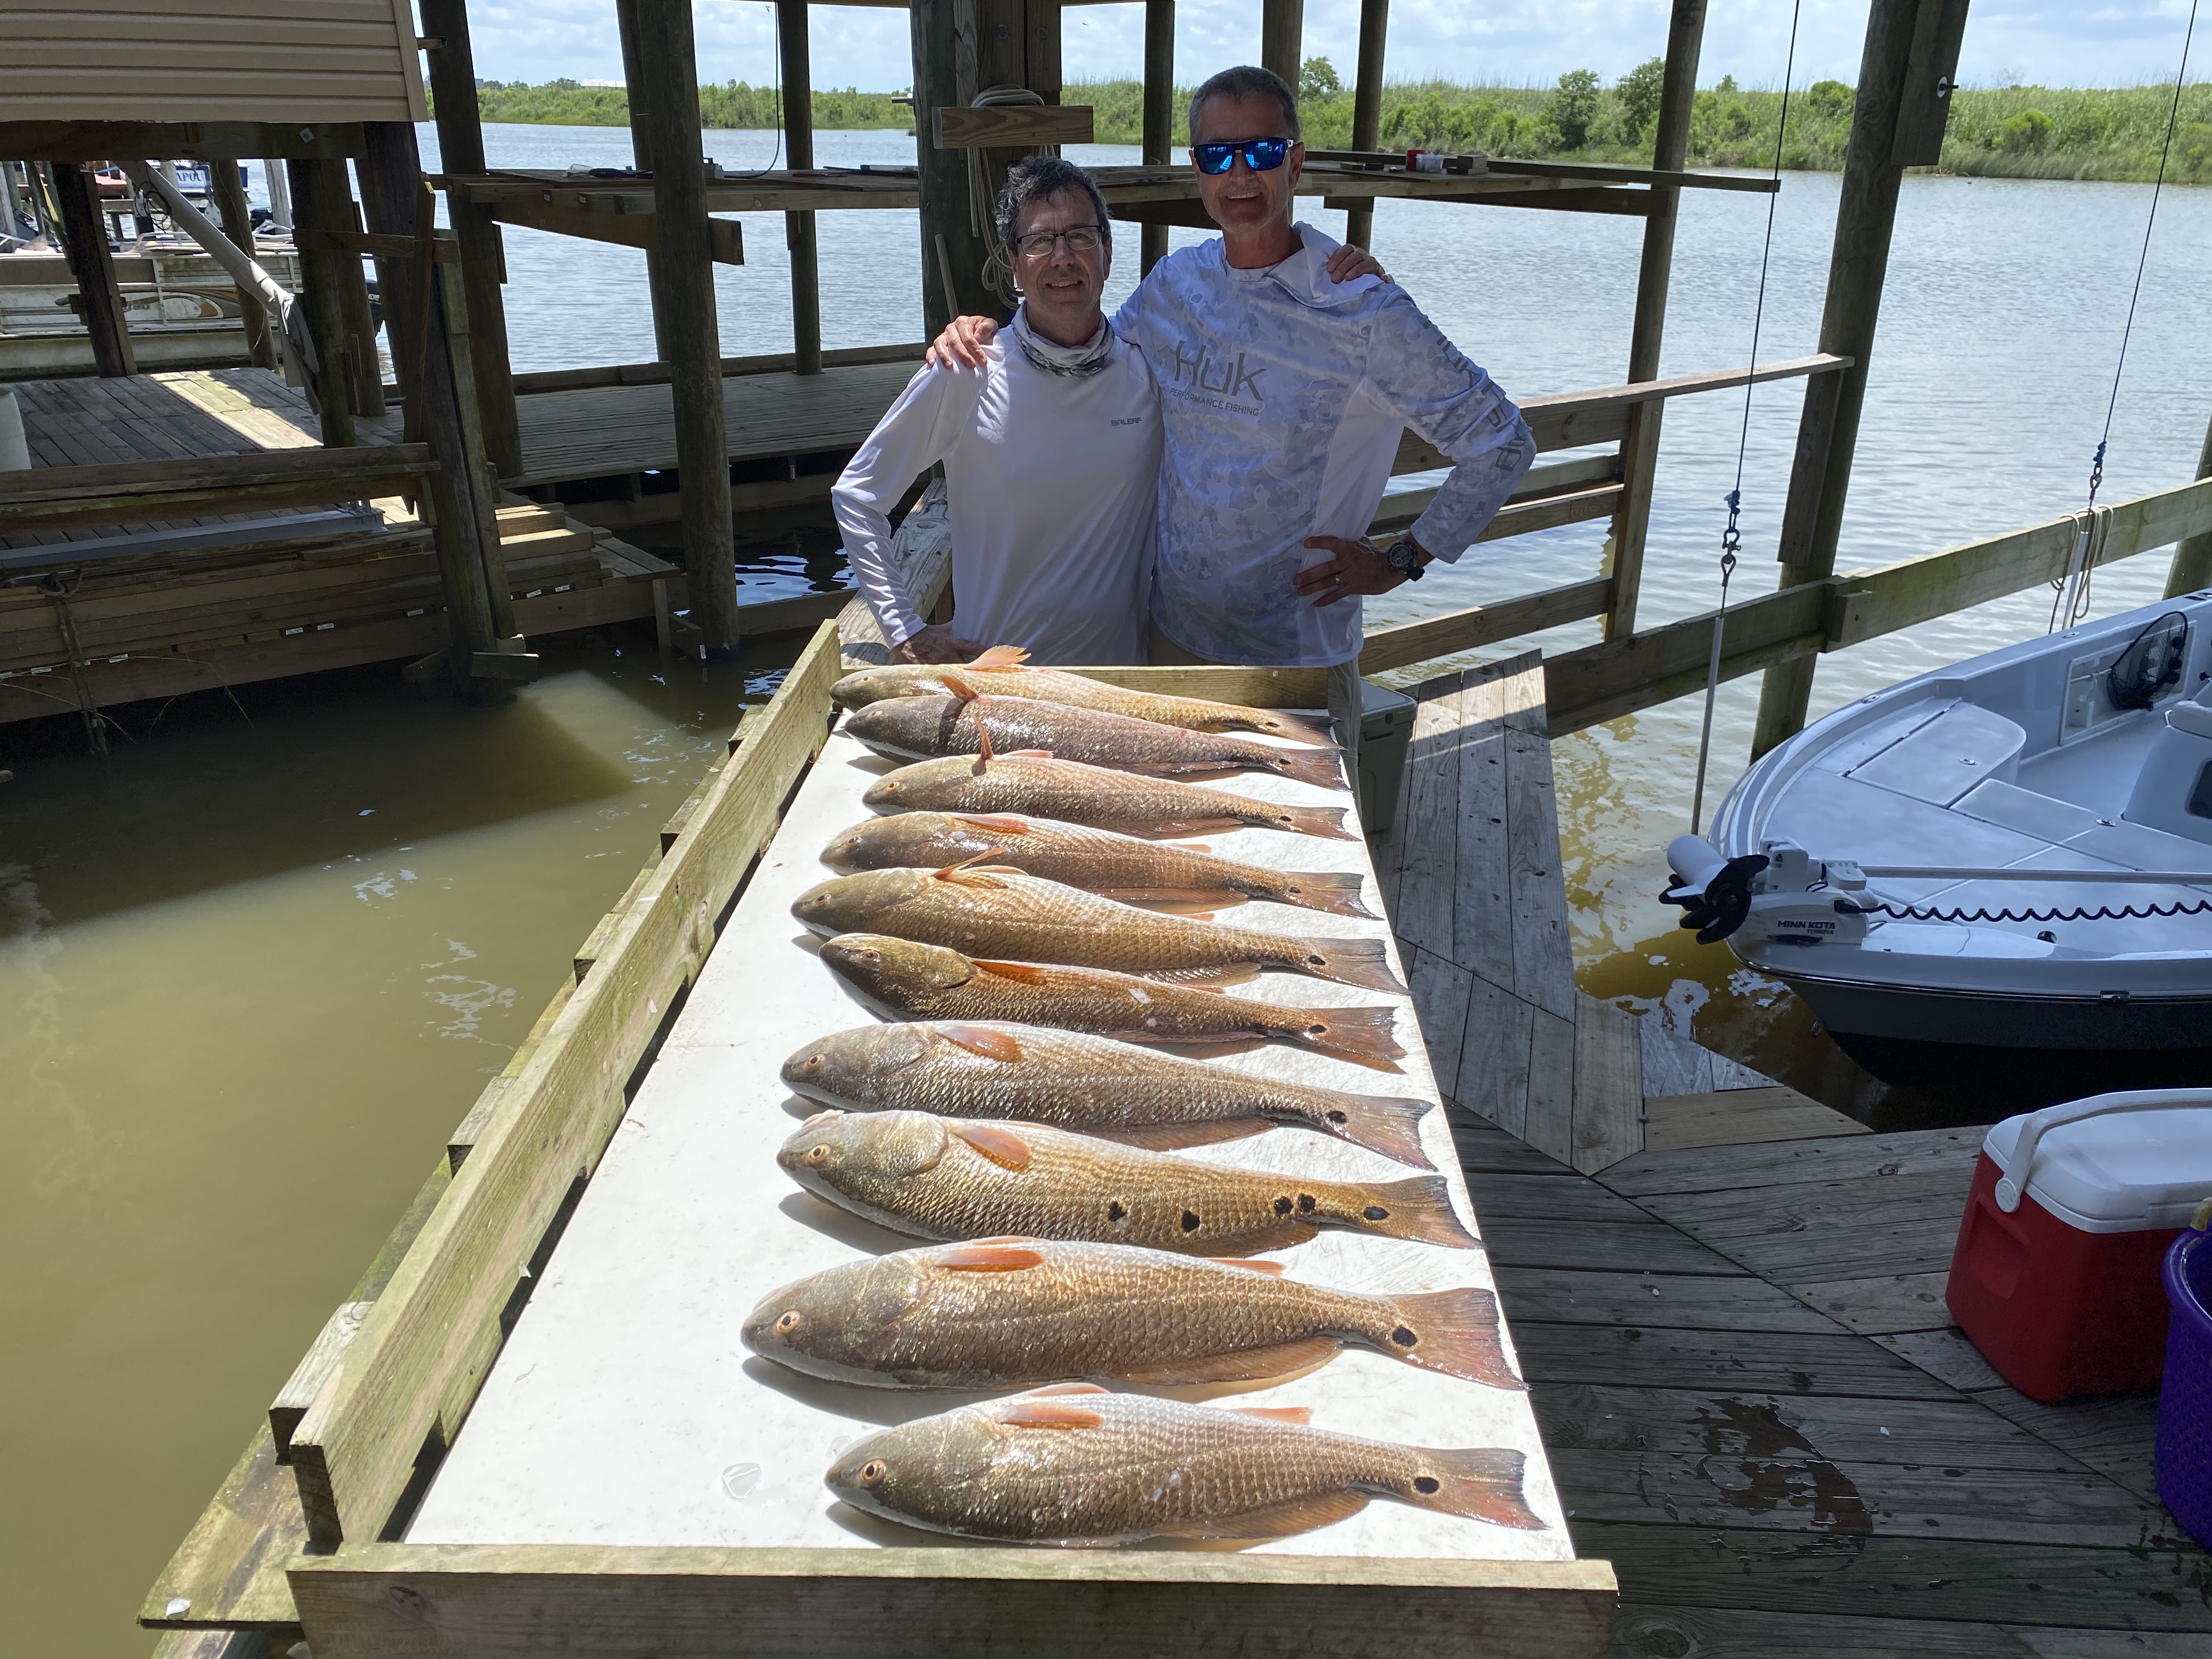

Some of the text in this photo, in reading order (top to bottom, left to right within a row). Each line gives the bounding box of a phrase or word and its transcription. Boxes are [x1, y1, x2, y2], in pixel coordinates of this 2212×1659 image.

[1169, 387, 1259, 416] PERFORMANCE FISHING
[1110, 417, 1142, 426] BALEAF
[1777, 920, 1807, 928] MINN
